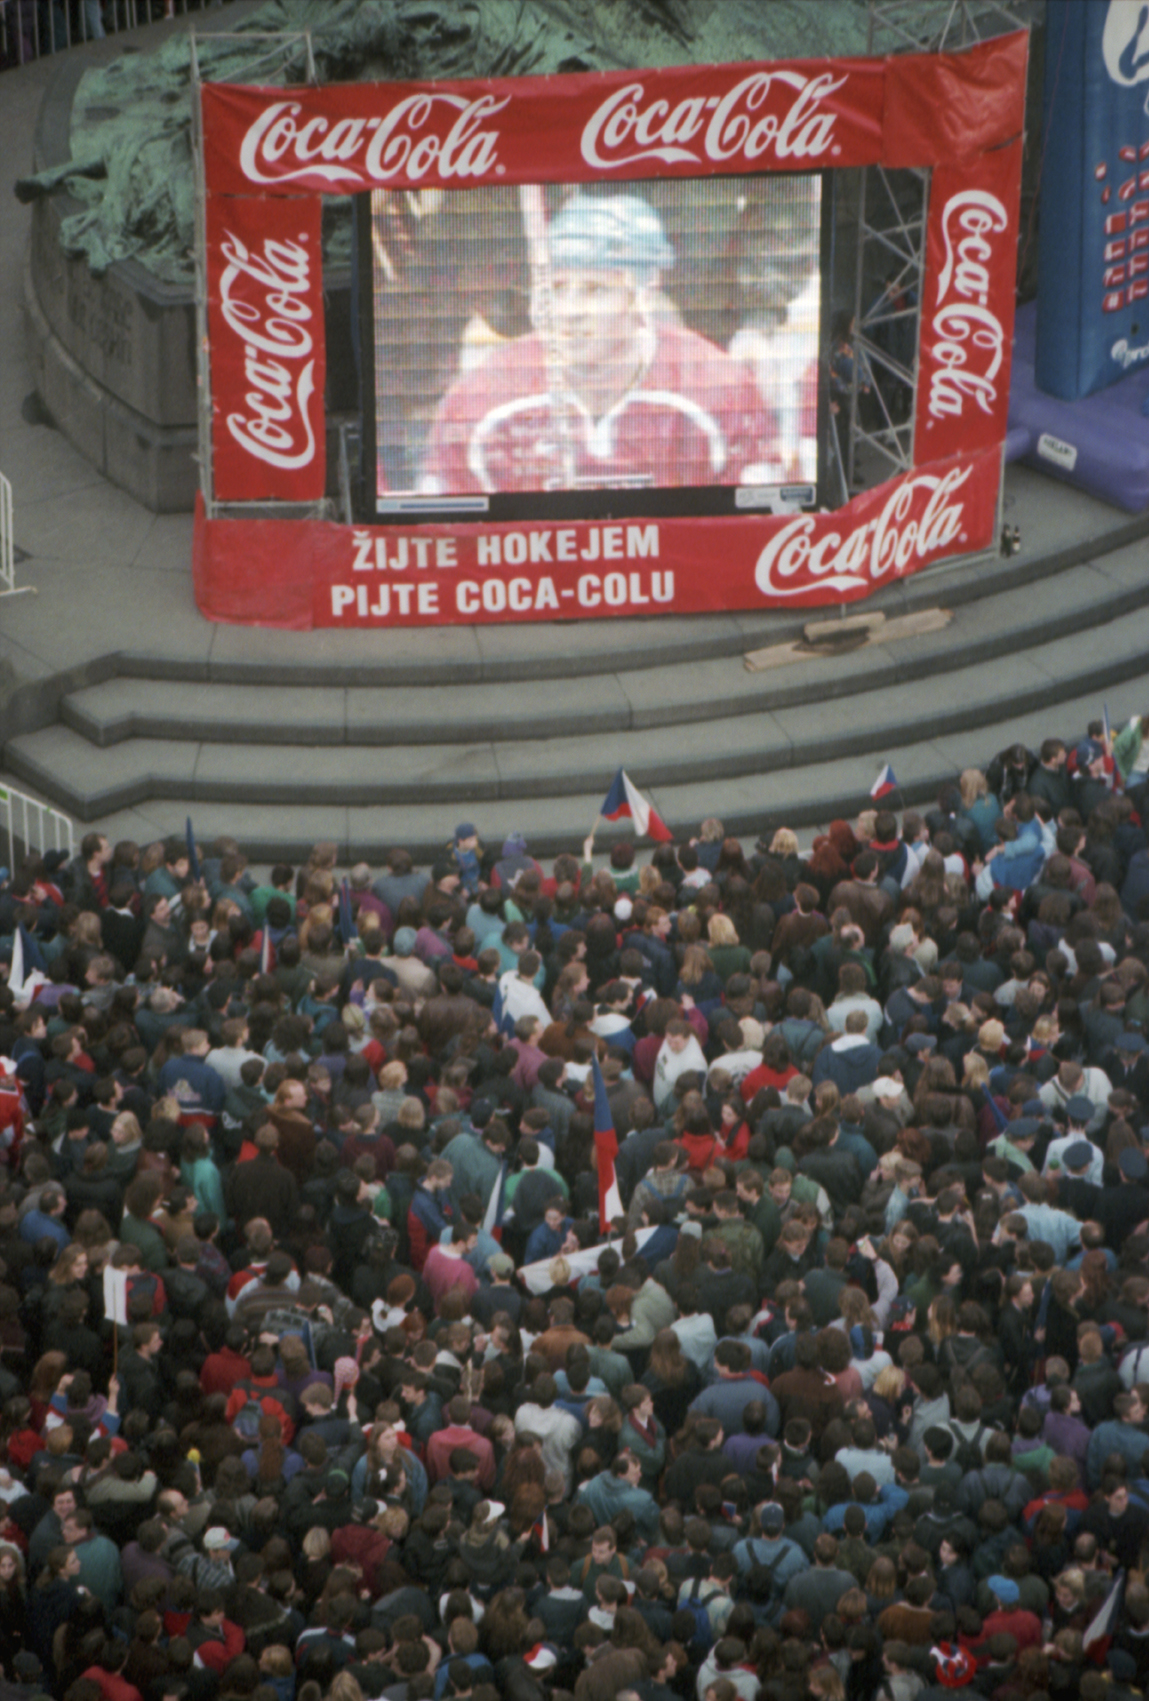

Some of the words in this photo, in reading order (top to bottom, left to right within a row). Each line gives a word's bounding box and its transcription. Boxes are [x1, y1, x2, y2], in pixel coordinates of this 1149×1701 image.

[239, 93, 511, 183] Coca-Cola
[580, 71, 848, 168] Coca-Cola
[219, 228, 315, 469] Coca-Cola
[929, 189, 1007, 420] Coca-Cola
[352, 530, 458, 571] ŽIJTE
[477, 525, 660, 566] HOKEJEM
[755, 464, 973, 596] Coca-Cola
[331, 583, 439, 617] PIJTE
[455, 570, 675, 614] COCA-COLU
